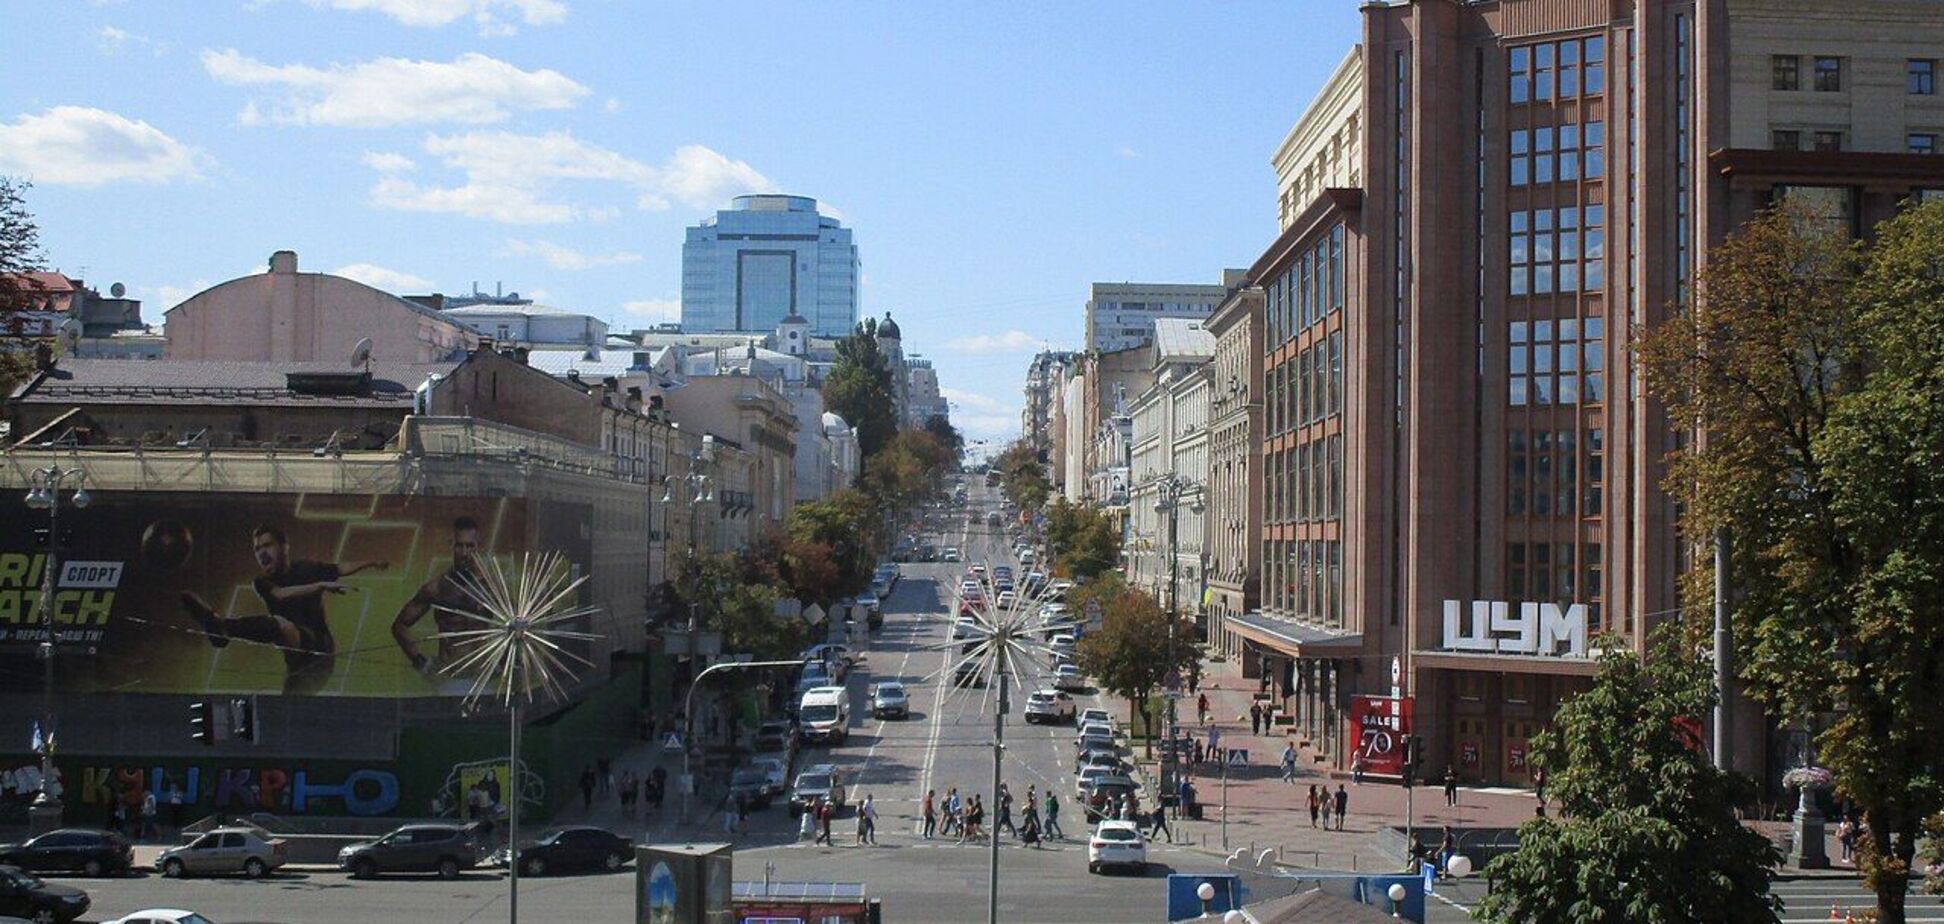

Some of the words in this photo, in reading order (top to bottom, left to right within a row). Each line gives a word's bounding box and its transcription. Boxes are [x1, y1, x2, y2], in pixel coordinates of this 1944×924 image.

[67, 566, 117, 582] СПОРТ
[1443, 600, 1588, 656] ЦУМ
[1362, 715, 1390, 726] SALE
[215, 768, 399, 815] КРЮ
